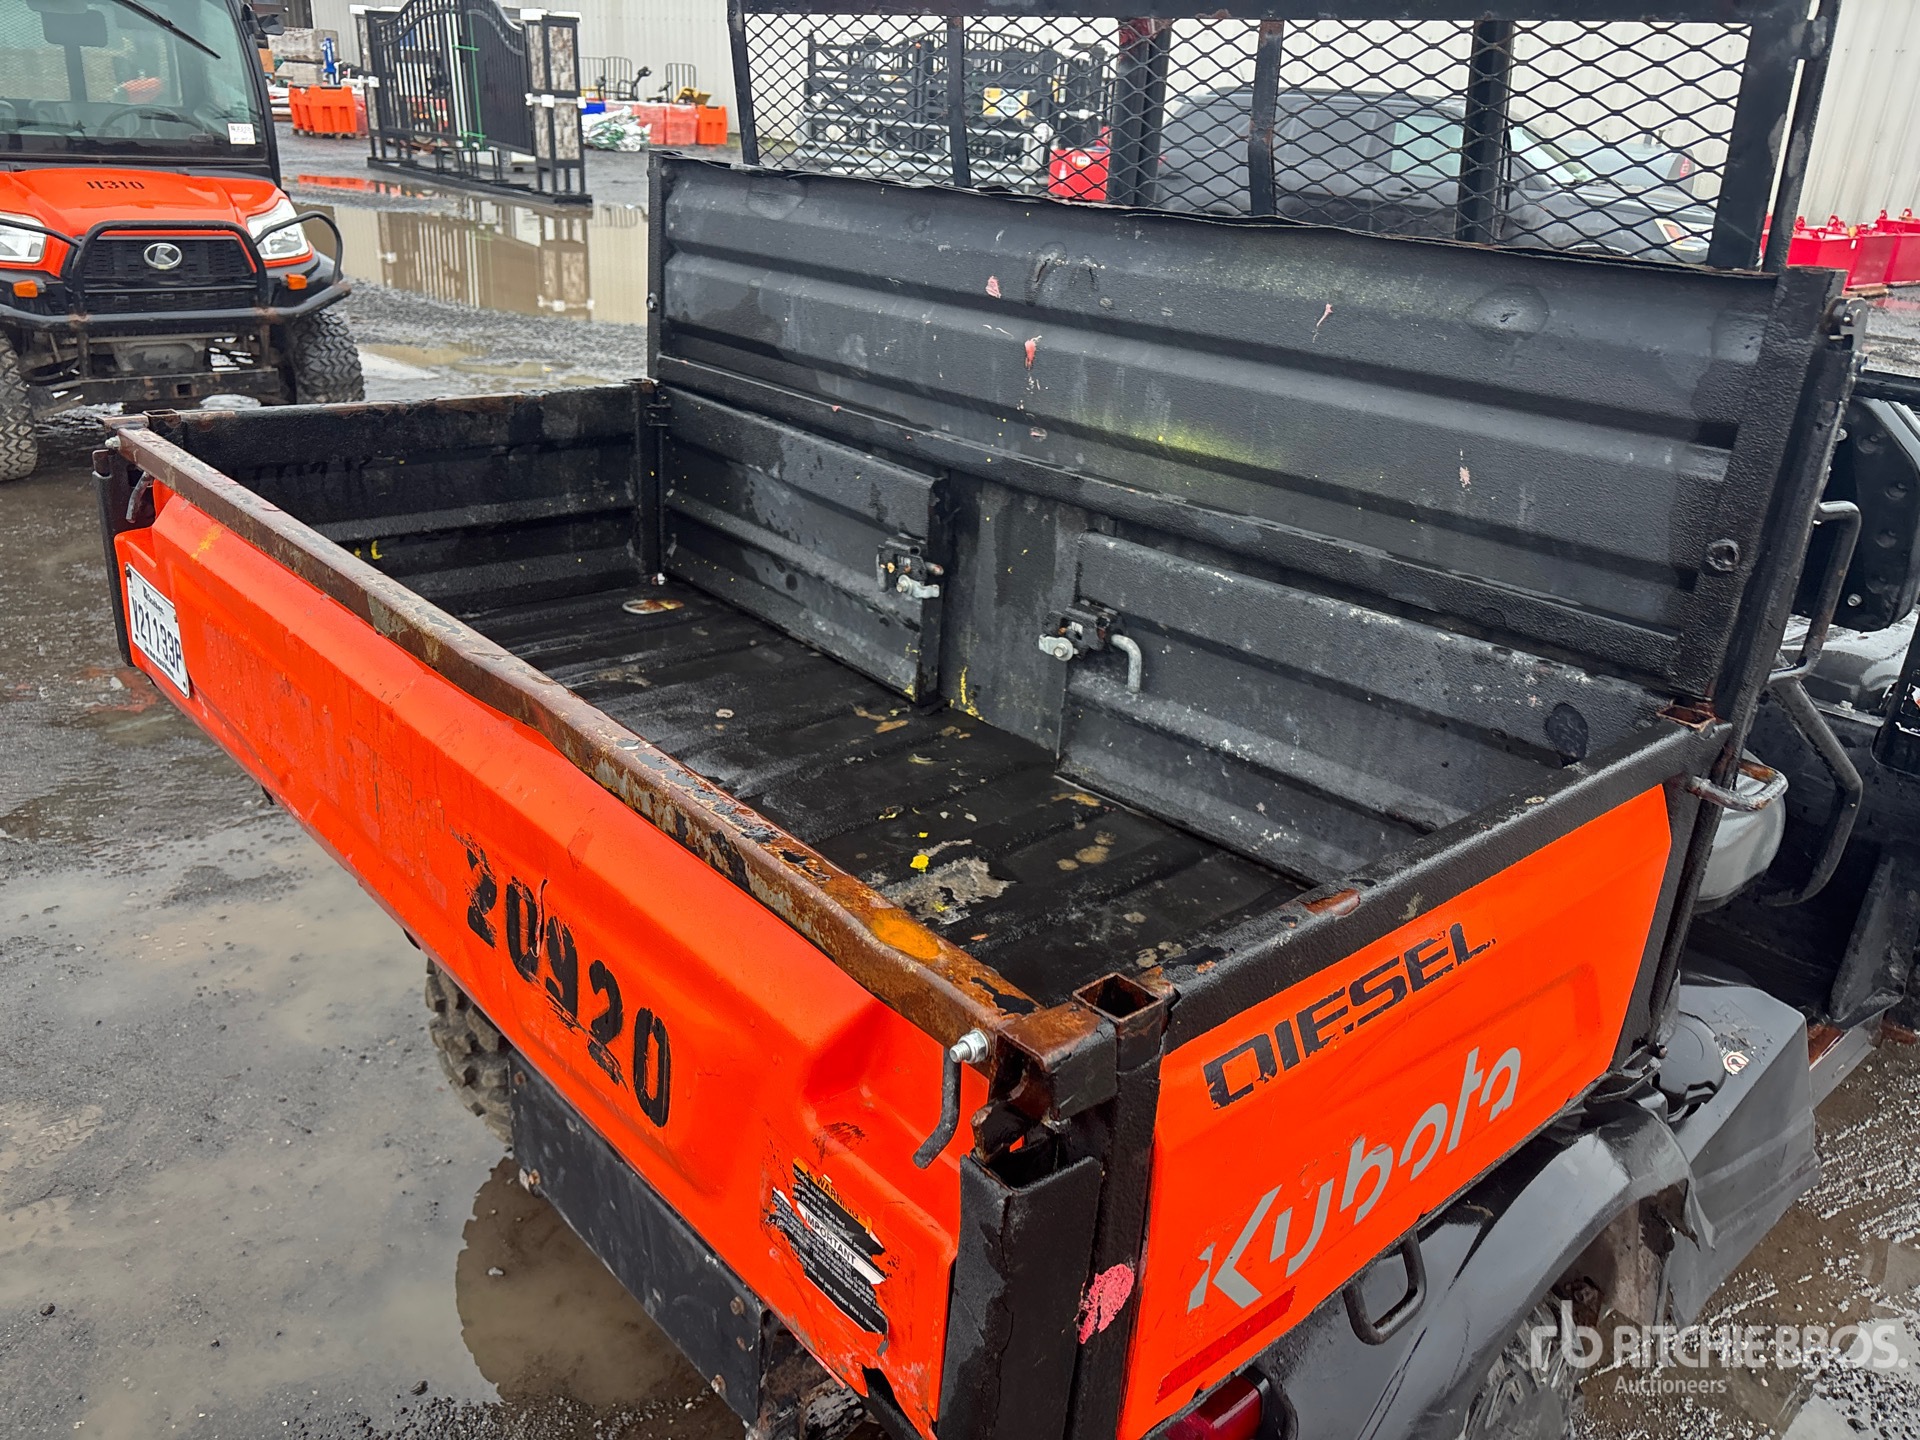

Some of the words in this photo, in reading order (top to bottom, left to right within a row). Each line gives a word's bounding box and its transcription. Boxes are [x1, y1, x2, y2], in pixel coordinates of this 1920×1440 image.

[463, 836, 671, 1127] 20920
[1203, 923, 1496, 1109] DIESEL
[805, 1211, 857, 1264] IMPORTANT
[1187, 1047, 1522, 1313] Kubota
